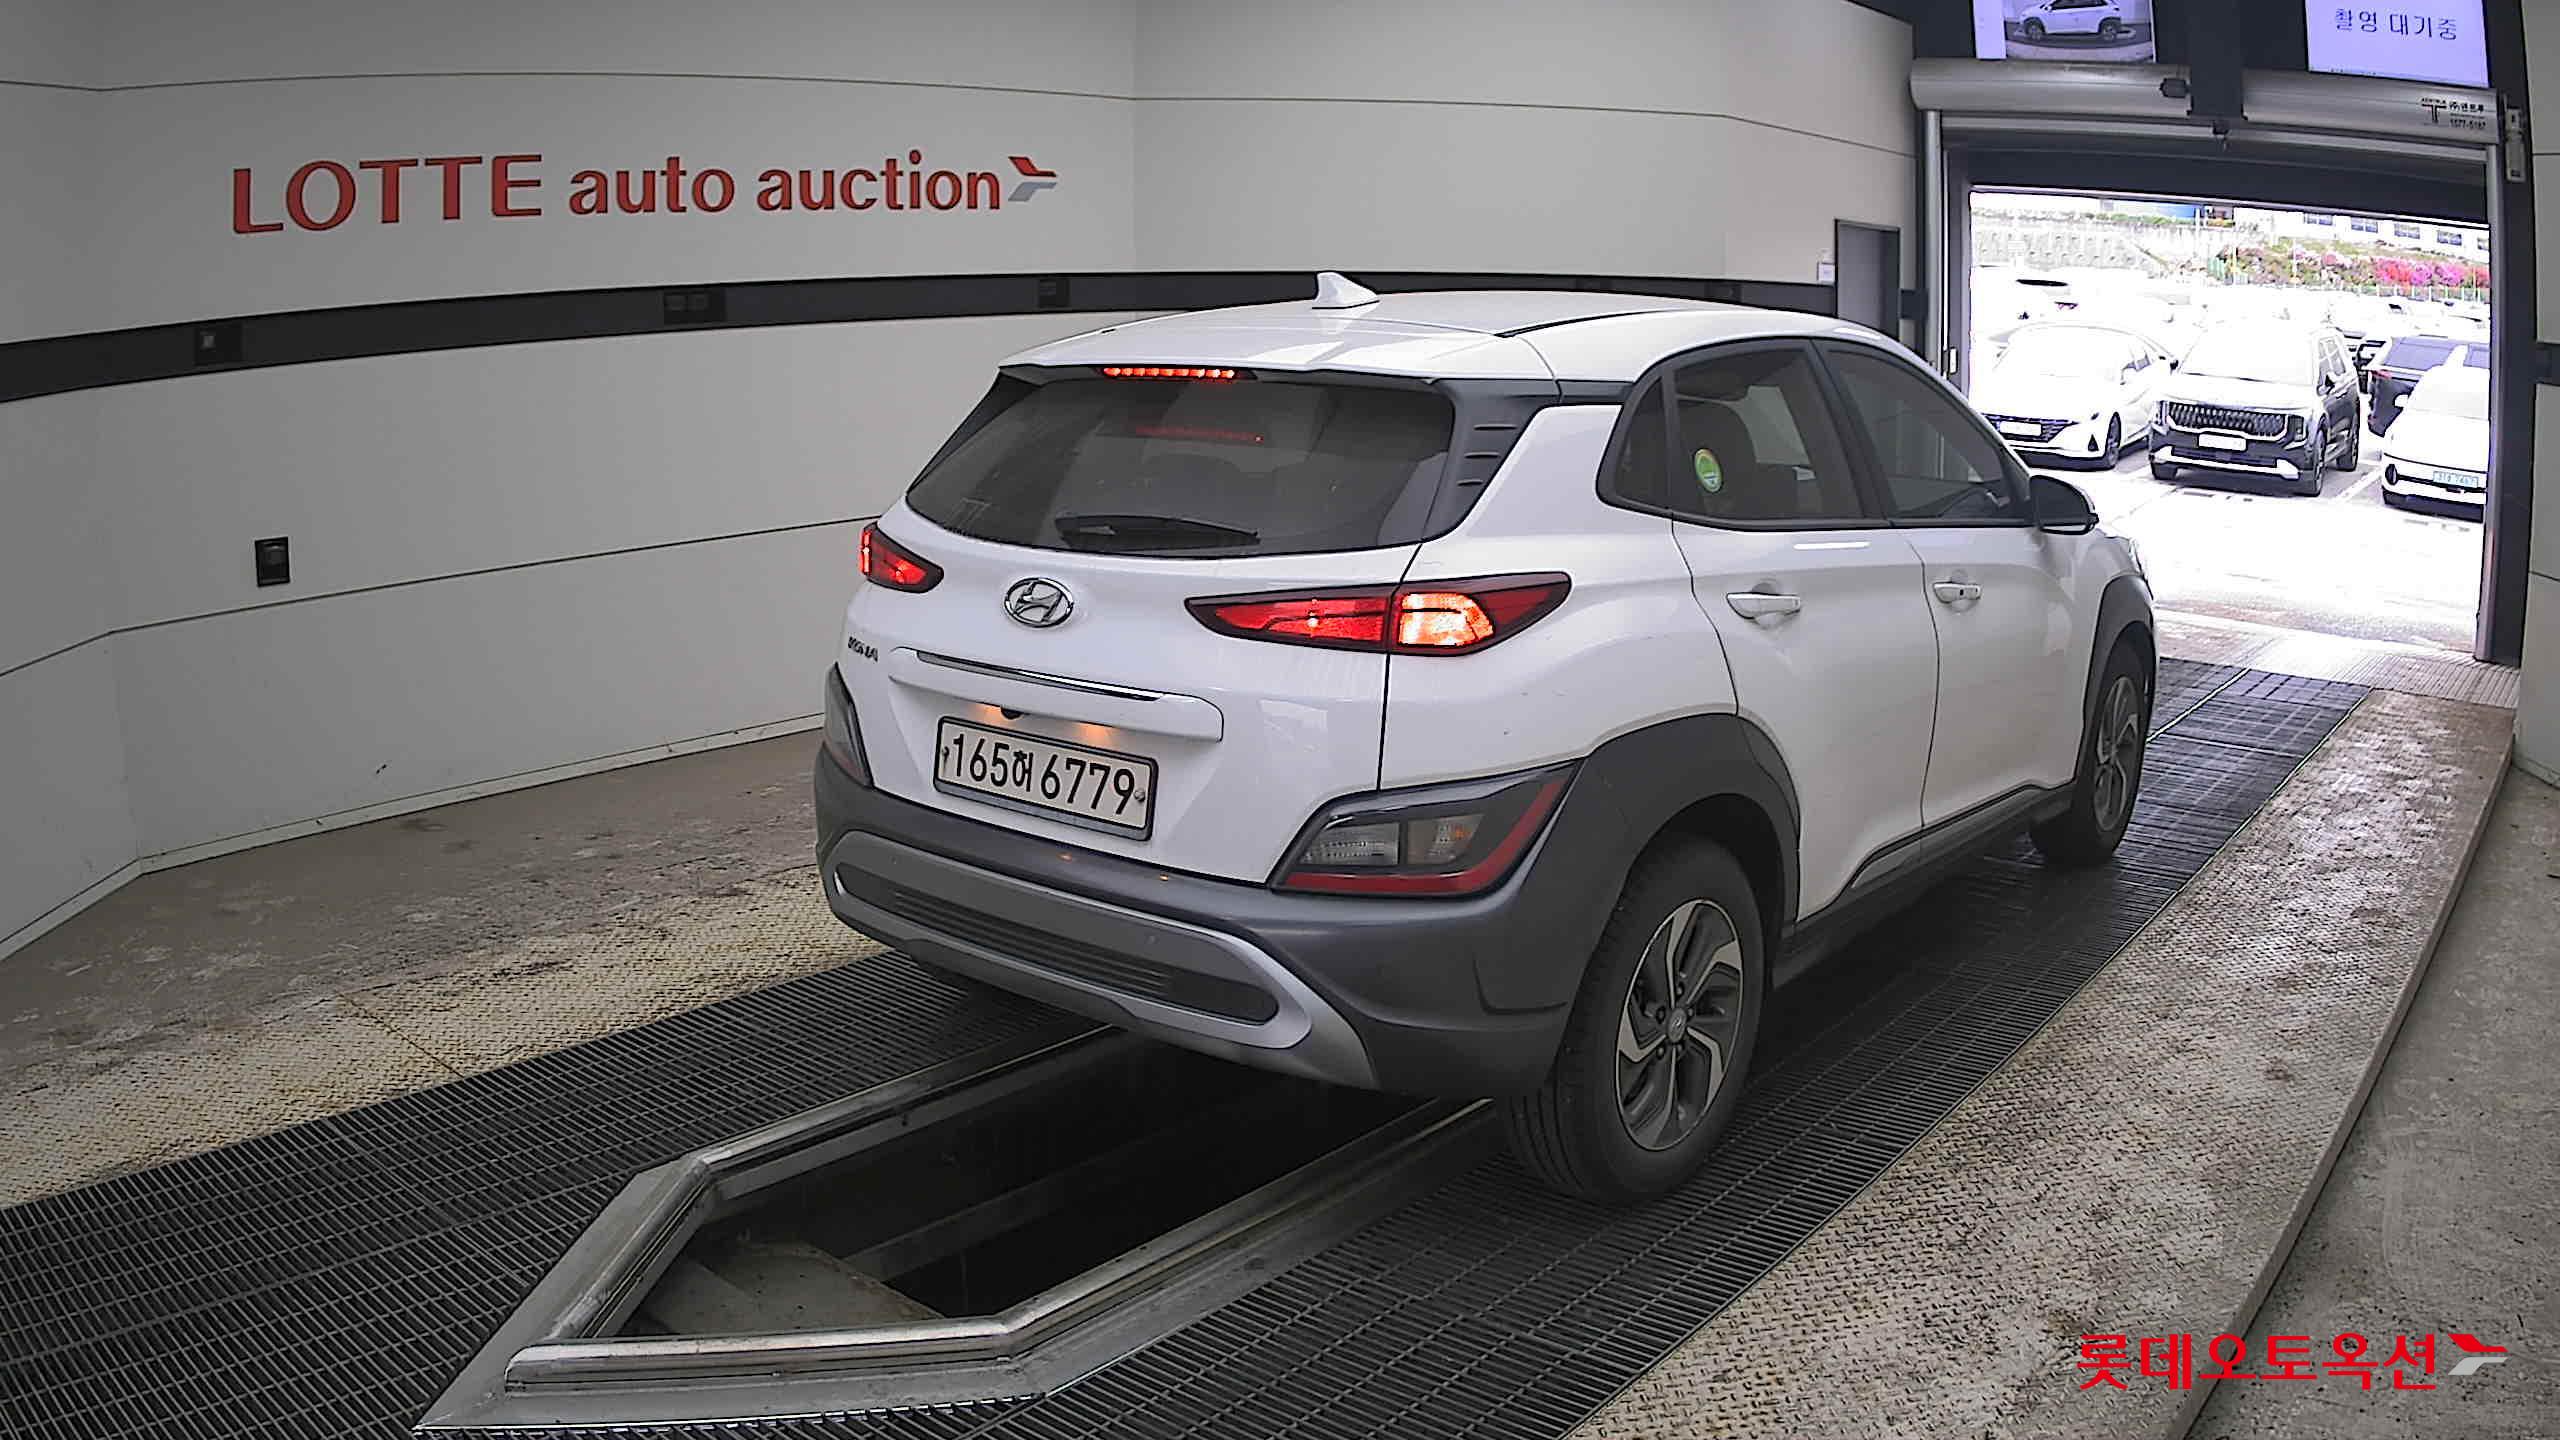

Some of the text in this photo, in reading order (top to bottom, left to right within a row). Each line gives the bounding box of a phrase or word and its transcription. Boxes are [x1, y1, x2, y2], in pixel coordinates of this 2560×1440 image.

[2335, 8, 2457, 41] 촬영 대기중
[234, 149, 1002, 234] LOTTE auto auction
